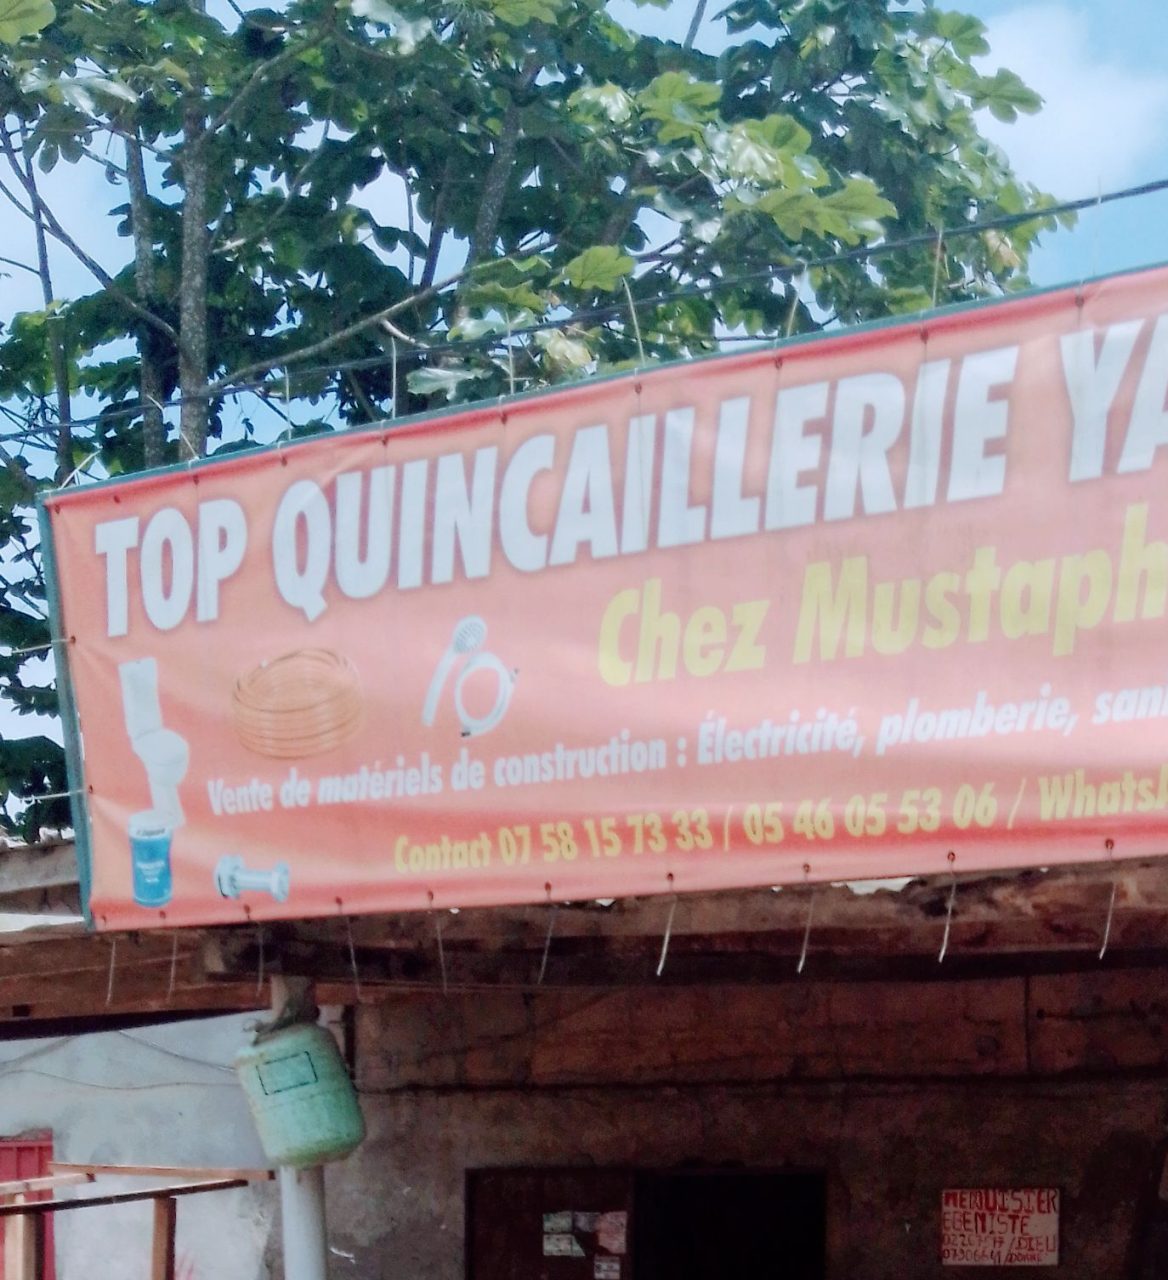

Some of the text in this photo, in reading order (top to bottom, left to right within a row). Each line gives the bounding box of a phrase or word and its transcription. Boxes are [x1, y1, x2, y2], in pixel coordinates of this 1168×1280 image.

[96, 499, 248, 638] TOP
[272, 346, 1019, 622] QUINCAILLERIE
[598, 577, 770, 687] Chez
[208, 778, 273, 816] Vente
[280, 767, 310, 807] de
[318, 752, 443, 805] matériels
[451, 748, 485, 790] de
[494, 729, 667, 787] construction
[697, 707, 865, 765] Électricité,
[875, 683, 1078, 756] plomberie,
[395, 833, 491, 873] Contact
[500, 825, 531, 866] 07
[540, 821, 578, 863] 58
[583, 817, 621, 858] 15
[632, 813, 667, 854] 73
[672, 810, 713, 851] 33
[743, 802, 784, 845] 05
[793, 798, 836, 840] 46
[844, 793, 888, 837] 05
[897, 786, 942, 834] 53
[952, 782, 998, 830] 06
